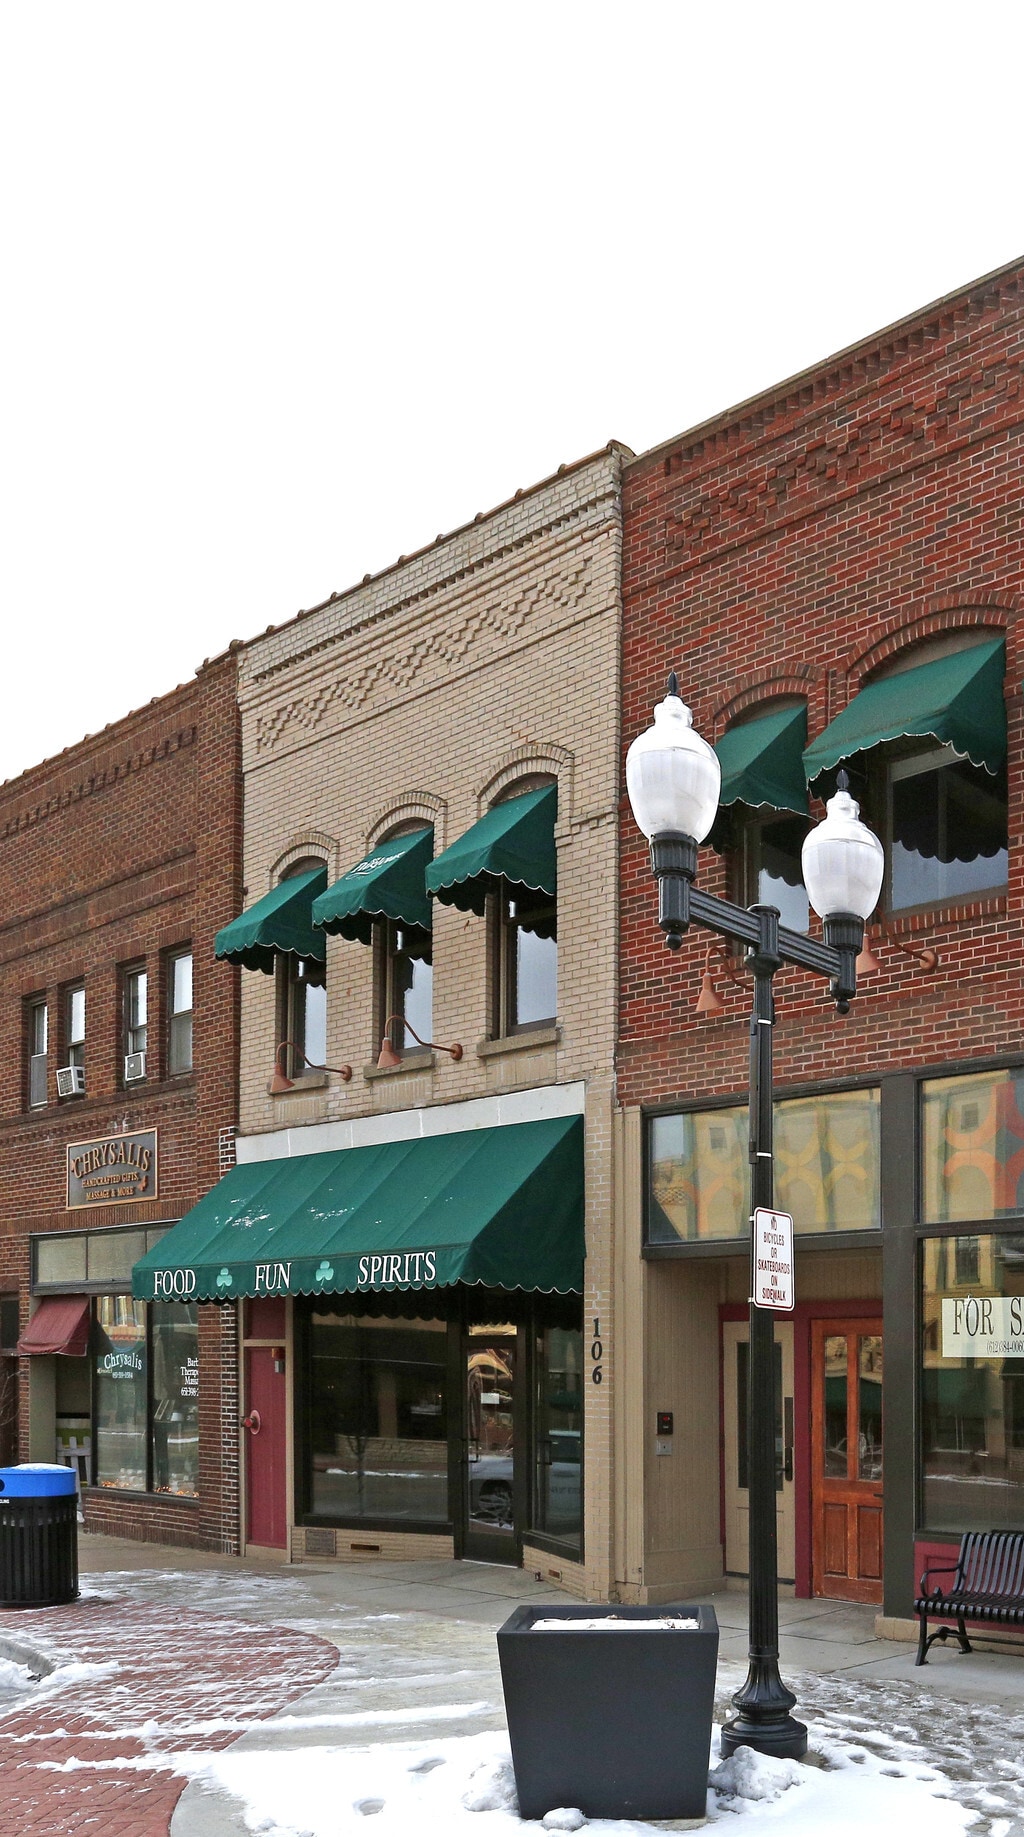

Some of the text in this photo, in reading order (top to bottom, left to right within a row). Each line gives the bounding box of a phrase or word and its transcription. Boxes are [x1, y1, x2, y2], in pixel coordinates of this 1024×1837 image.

[73, 1141, 150, 1179] CHRYSALIS
[82, 1174, 121, 1188] HANDCRAFTED
[86, 1189, 110, 1200] MASSAGE
[118, 1186, 135, 1197] MORE
[763, 1231, 785, 1246] BICYCLES
[770, 1247, 778, 1258] OR
[152, 1251, 437, 1296] FOOD FUN SPIRITS
[758, 1259, 790, 1275] SKATEBOARDS
[770, 1275, 778, 1286] ON
[762, 1287, 786, 1301] SIDEWALK
[952, 1298, 995, 1337] FOR
[104, 1353, 142, 1370] Chrysalis
